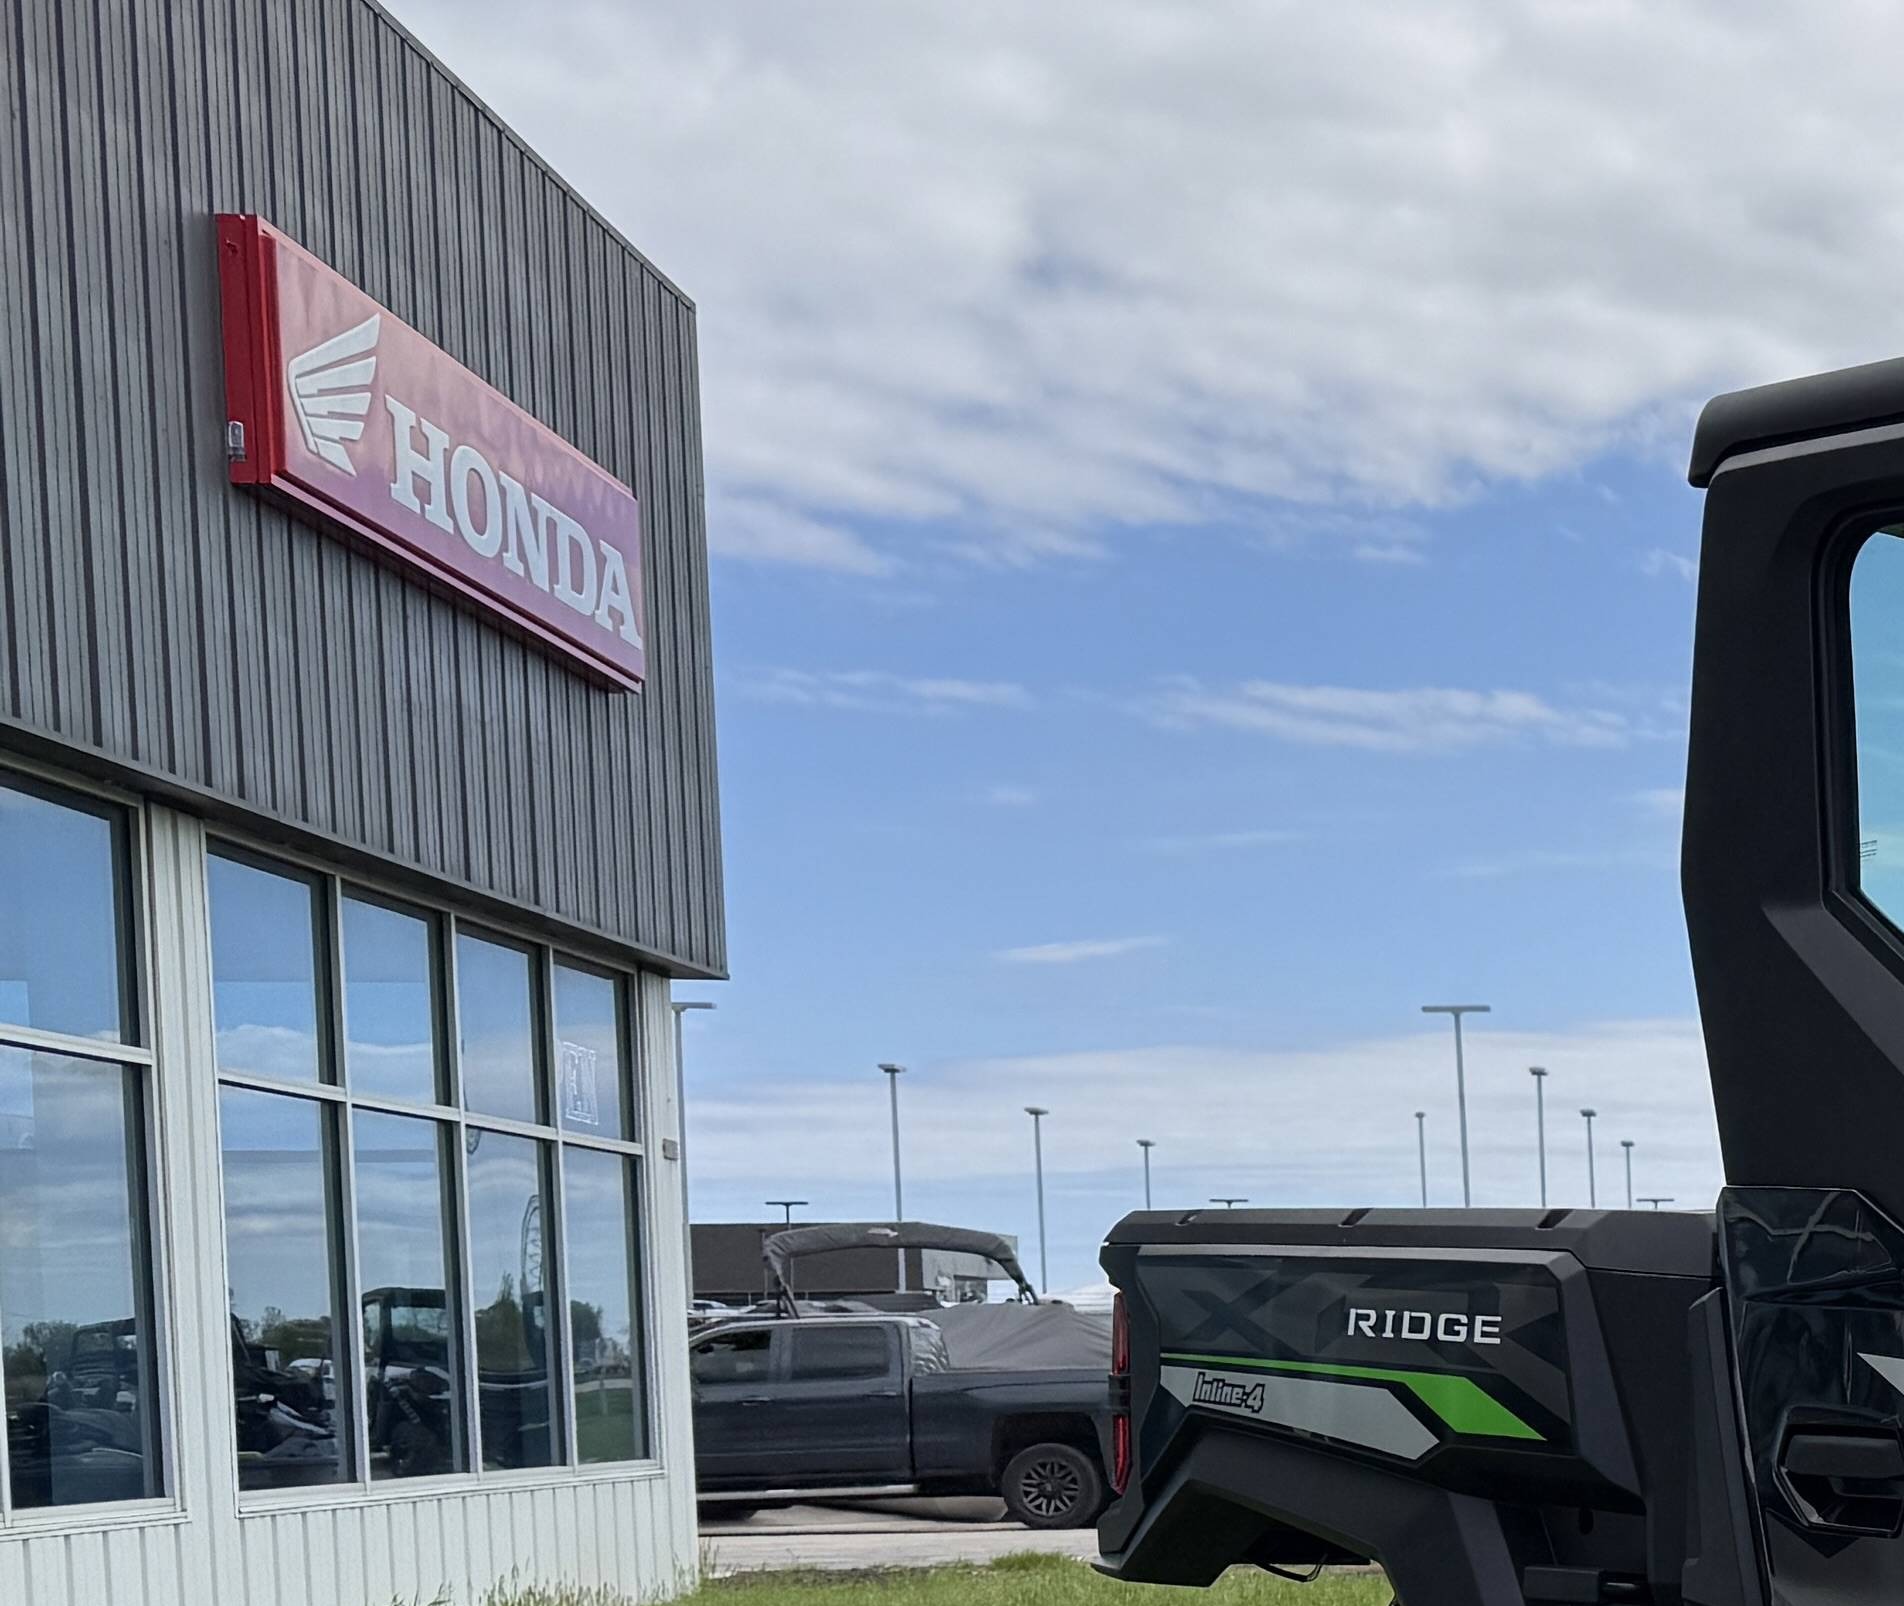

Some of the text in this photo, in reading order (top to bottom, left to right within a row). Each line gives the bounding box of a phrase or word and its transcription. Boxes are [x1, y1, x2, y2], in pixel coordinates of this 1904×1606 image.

[384, 393, 642, 651] HONDA
[1347, 1308, 1503, 1345] RIDGE
[1192, 1371, 1266, 1413] Inline-4
